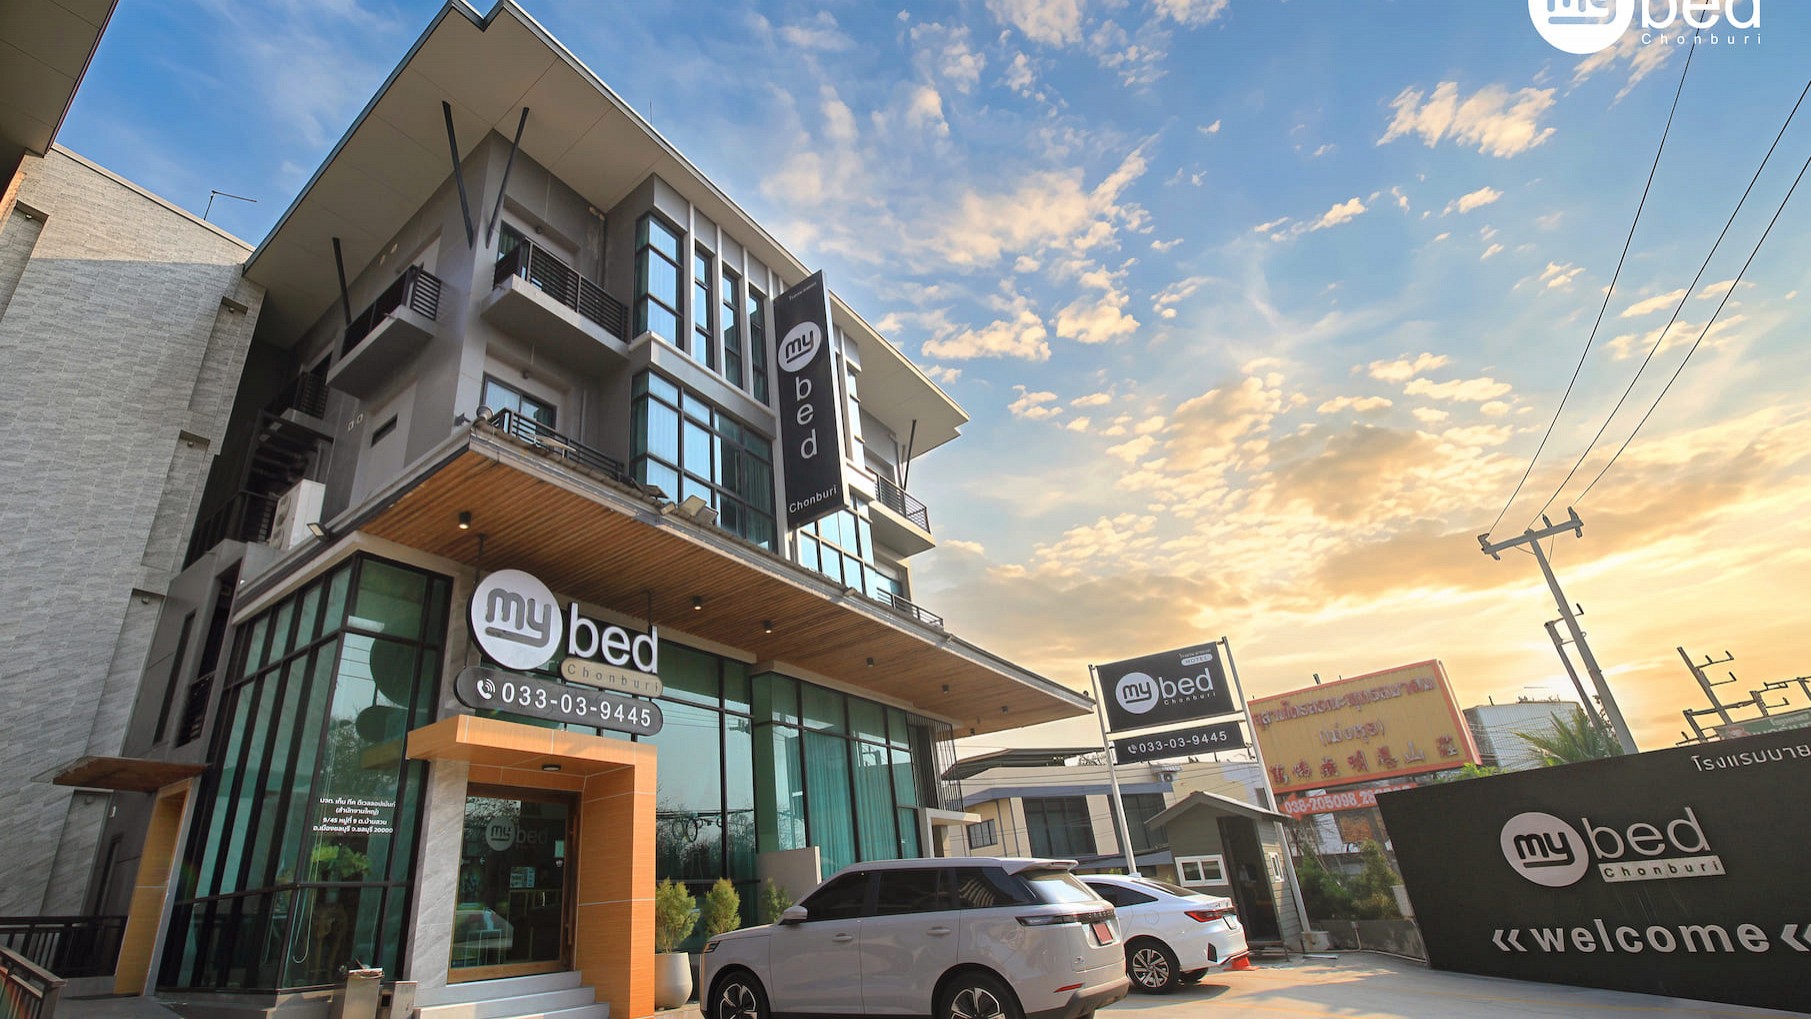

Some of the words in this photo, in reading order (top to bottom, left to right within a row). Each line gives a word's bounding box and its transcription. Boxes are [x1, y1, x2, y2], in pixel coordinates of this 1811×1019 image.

[785, 329, 814, 364] my
[795, 376, 818, 460] bed
[789, 484, 837, 514] Chonburi
[485, 587, 552, 649] my
[568, 602, 659, 674] bed
[567, 663, 659, 693] Chonburi
[1122, 681, 1153, 704] my
[1158, 667, 1214, 699] bed
[501, 682, 651, 727] 033-03-9445
[1163, 692, 1216, 706] Chonburi
[1139, 730, 1228, 753] 033-03-9445
[490, 824, 511, 841] my
[1514, 830, 1576, 869] my
[1581, 806, 1712, 860] bed
[1603, 859, 1720, 879] Chonburi
[1529, 918, 1771, 953] welcome
